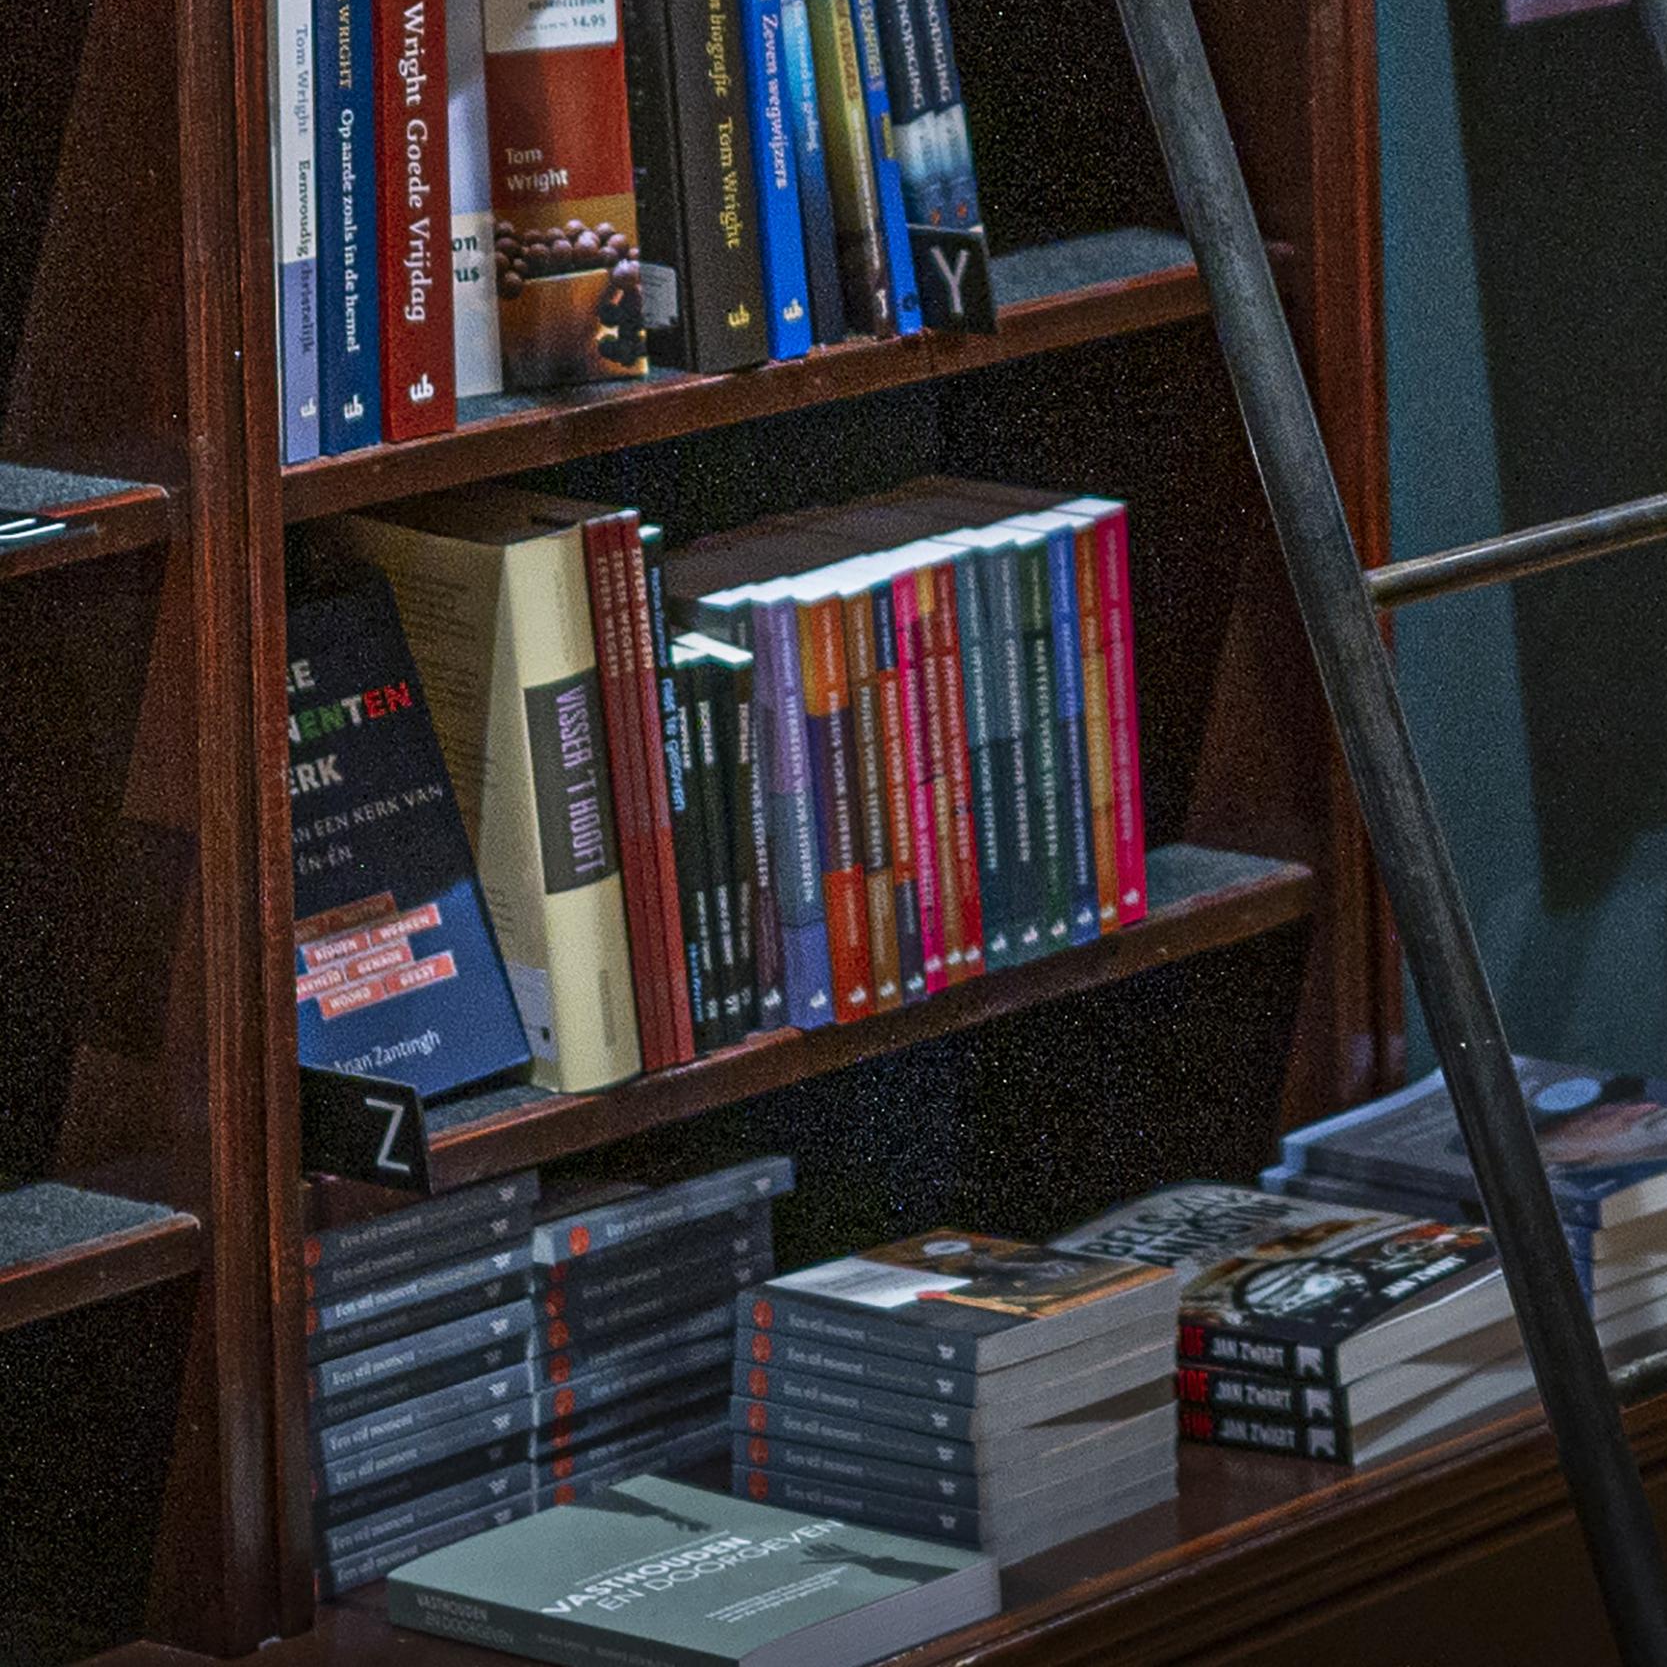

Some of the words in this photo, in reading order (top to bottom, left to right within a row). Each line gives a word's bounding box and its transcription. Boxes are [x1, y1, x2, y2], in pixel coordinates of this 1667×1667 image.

[337, 3, 352, 90] WRIGHT
[397, 1, 427, 107] Wright
[705, 13, 730, 98] biografie
[760, 13, 780, 74] Zeven
[337, 108, 355, 139] Op
[717, 117, 737, 167] Tom
[765, 78, 789, 189] wegwijzers
[341, 142, 357, 194] aarde
[406, 119, 430, 209] Goede
[295, 159, 313, 258] Eenvoudig
[343, 196, 358, 242] zoals
[718, 171, 743, 250] Wright
[345, 244, 359, 265] in
[345, 268, 360, 293] de
[403, 216, 433, 323] Vrijdag
[929, 246, 970, 314] Y
[346, 295, 361, 353] hemel
[555, 685, 593, 767] VISSER
[664, 718, 679, 736] te
[364, 1097, 411, 1172] Z
[540, 1536, 752, 1614] VASTHOUDEN
[596, 1587, 645, 1611] EN
[642, 1519, 845, 1591] DOORGEVEN
